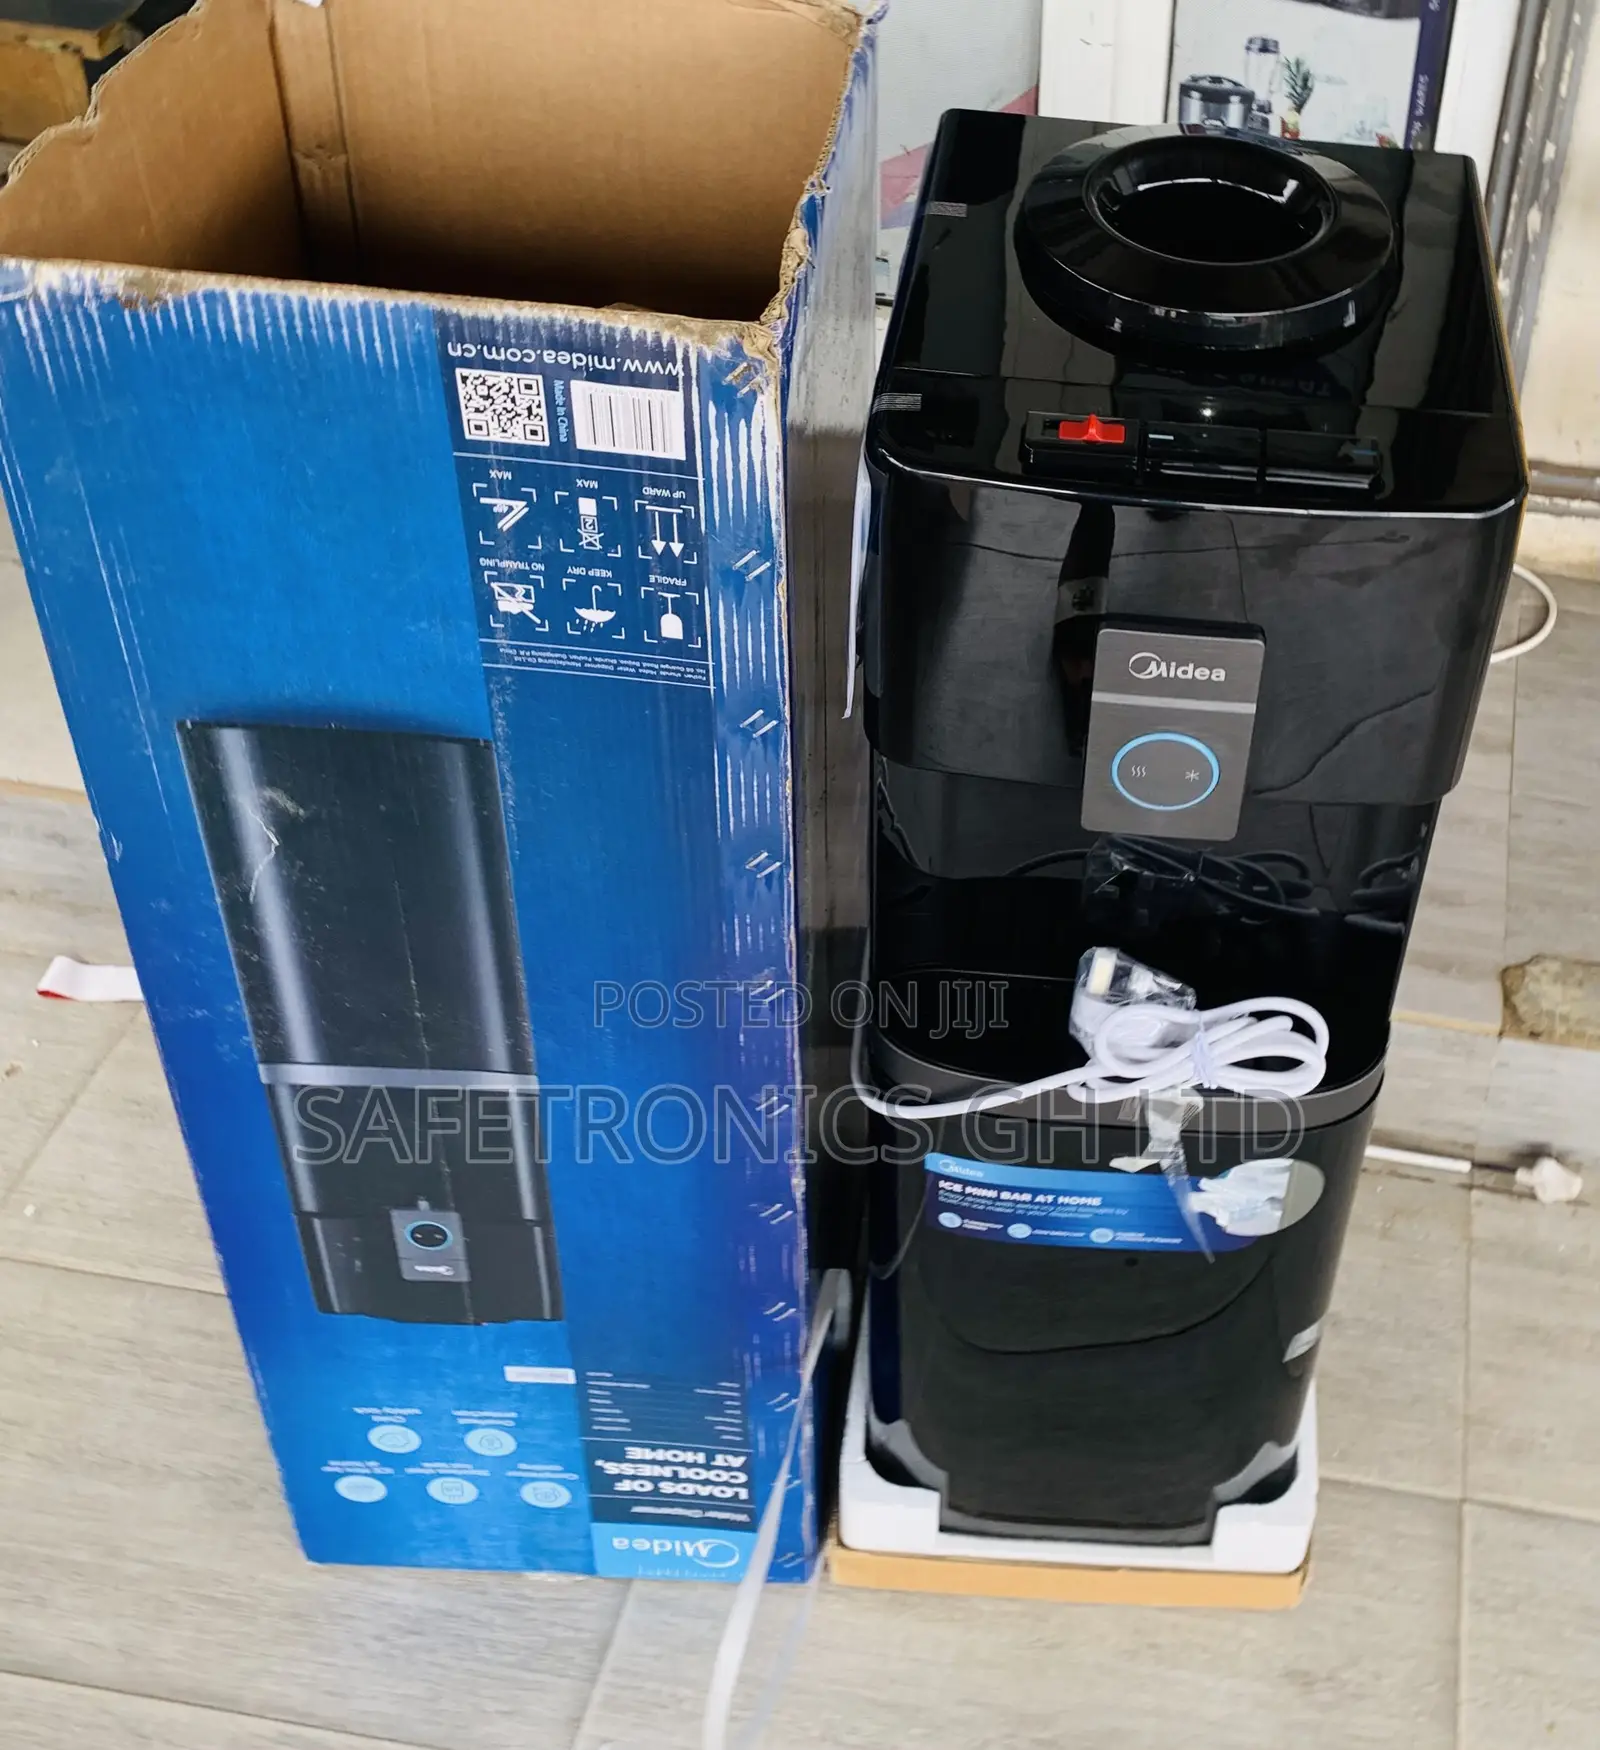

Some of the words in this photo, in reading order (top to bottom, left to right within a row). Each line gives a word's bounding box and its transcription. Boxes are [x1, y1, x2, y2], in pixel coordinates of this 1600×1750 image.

[447, 341, 684, 377] www.midea.com.cn
[553, 379, 566, 406] Made
[557, 416, 569, 442] China
[489, 469, 512, 481] MAX
[576, 478, 599, 489] MAX
[642, 486, 671, 498] WARD
[672, 489, 686, 499] UP
[479, 557, 531, 571] TRAMPLING
[531, 562, 545, 572] NO
[566, 565, 587, 576] DRY
[588, 568, 612, 579] KEEP
[648, 574, 688, 587] FRAGILE
[1128, 651, 1227, 682] Midea
[1034, 1193, 1056, 1204] AT
[1057, 1195, 1103, 1207] HOME
[624, 1446, 706, 1465] HOME
[711, 1453, 748, 1468] AT
[594, 1459, 749, 1484] COOLNESS,
[614, 1478, 655, 1492] OF
[657, 1481, 749, 1500] LOADS
[612, 1537, 740, 1568] Midea
